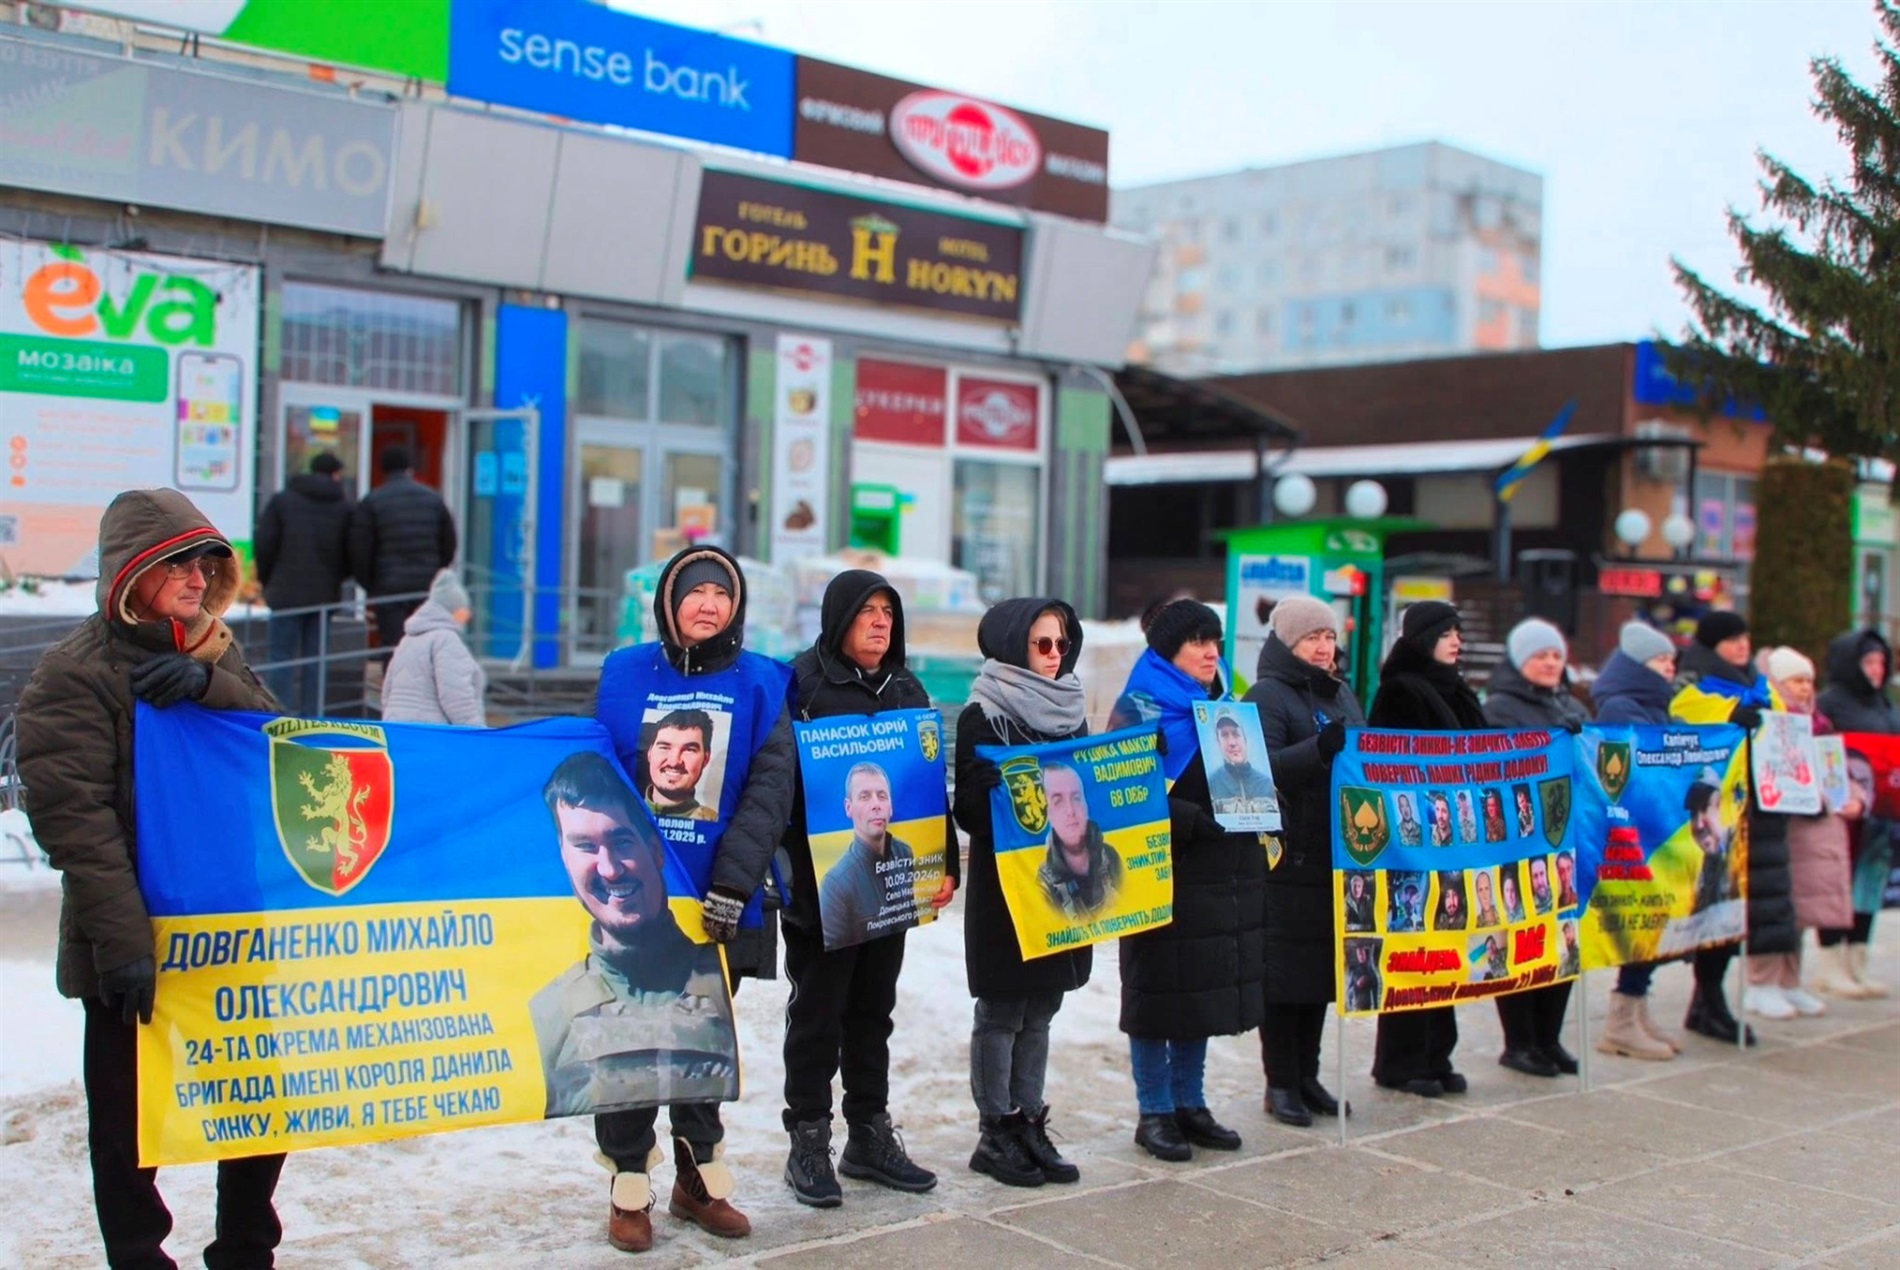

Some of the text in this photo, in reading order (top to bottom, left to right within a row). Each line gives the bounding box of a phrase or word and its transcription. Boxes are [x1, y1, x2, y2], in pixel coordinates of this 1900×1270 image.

[499, 27, 750, 111] sense bank
[738, 200, 808, 231] ГОТЕЛЬ
[702, 225, 838, 276] ГОРИНЬ
[907, 258, 1017, 302] HORYN
[24, 262, 217, 347] eva
[800, 717, 908, 744] ПАНАСЮК ЮРІЙ
[811, 738, 905, 760] ВАСИЛЬОВИЧ
[1093, 755, 1157, 782] ВАДИМОВИЧ
[1110, 789, 1124, 808] 68
[875, 853, 944, 874] Безвісти зник
[160, 910, 495, 971] ДОВГАНЕНКО МИХАЙЛО
[1088, 922, 1103, 938] ТА
[1102, 910, 1150, 935] ПОВЕРНІТЬ
[1514, 922, 1547, 966] ВАС
[214, 968, 467, 1022] ОЛЕКСАНДРОВИЧ
[185, 1012, 495, 1067] 24-ТА ОКРЕМА МЕХАНІЗОВАНА
[175, 1048, 513, 1108] БРИГАДА ІМЕНІ КОРОЛЯ ДАНИЛА
[201, 1086, 501, 1143] СИНКУ, ЖИВИ, Я ТЕБЕ ЧЕКАЮ
